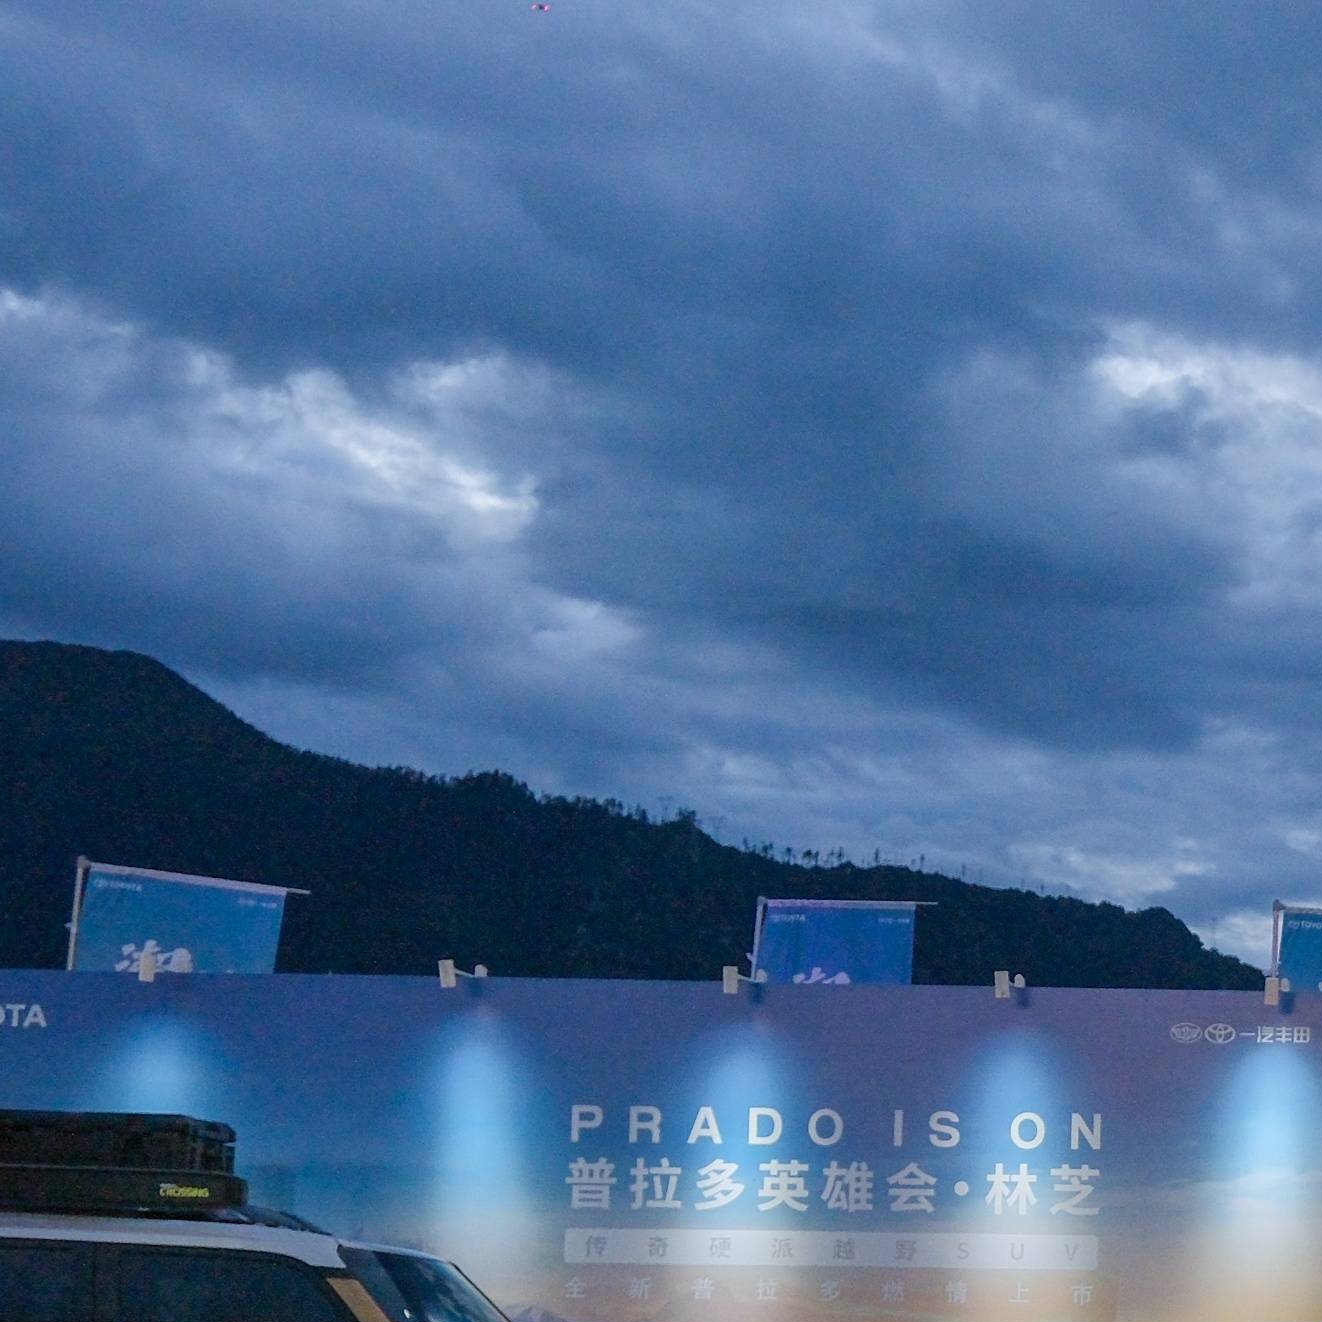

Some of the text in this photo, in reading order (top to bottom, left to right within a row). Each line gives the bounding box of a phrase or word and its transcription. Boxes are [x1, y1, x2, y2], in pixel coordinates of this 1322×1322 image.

[1239, 1025, 1311, 1044] 一汽丰田
[570, 1103, 1102, 1151] PRADO IS ON
